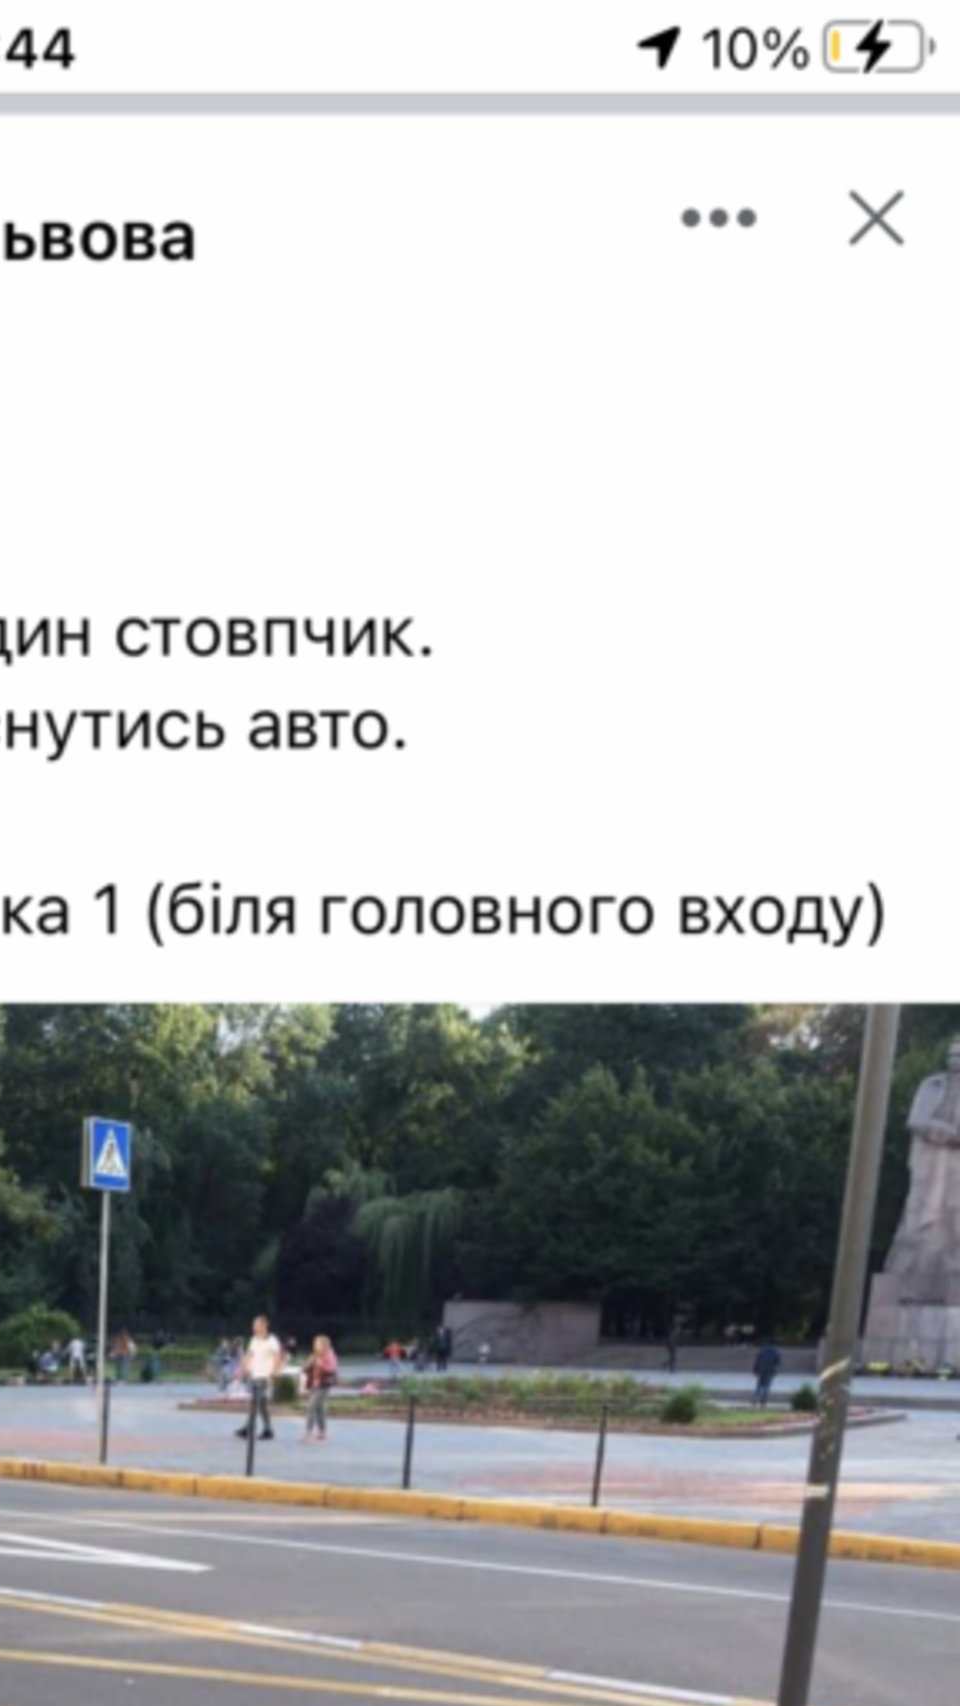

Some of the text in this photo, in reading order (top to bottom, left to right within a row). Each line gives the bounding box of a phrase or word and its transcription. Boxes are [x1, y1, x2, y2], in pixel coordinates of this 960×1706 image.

[703, 26, 810, 71] 10%
[116, 616, 432, 657] стовпчик.
[248, 709, 405, 750] авто.
[94, 883, 117, 935] 1
[147, 881, 295, 947] (біля
[321, 895, 654, 936] головного
[680, 882, 884, 948] входу)
